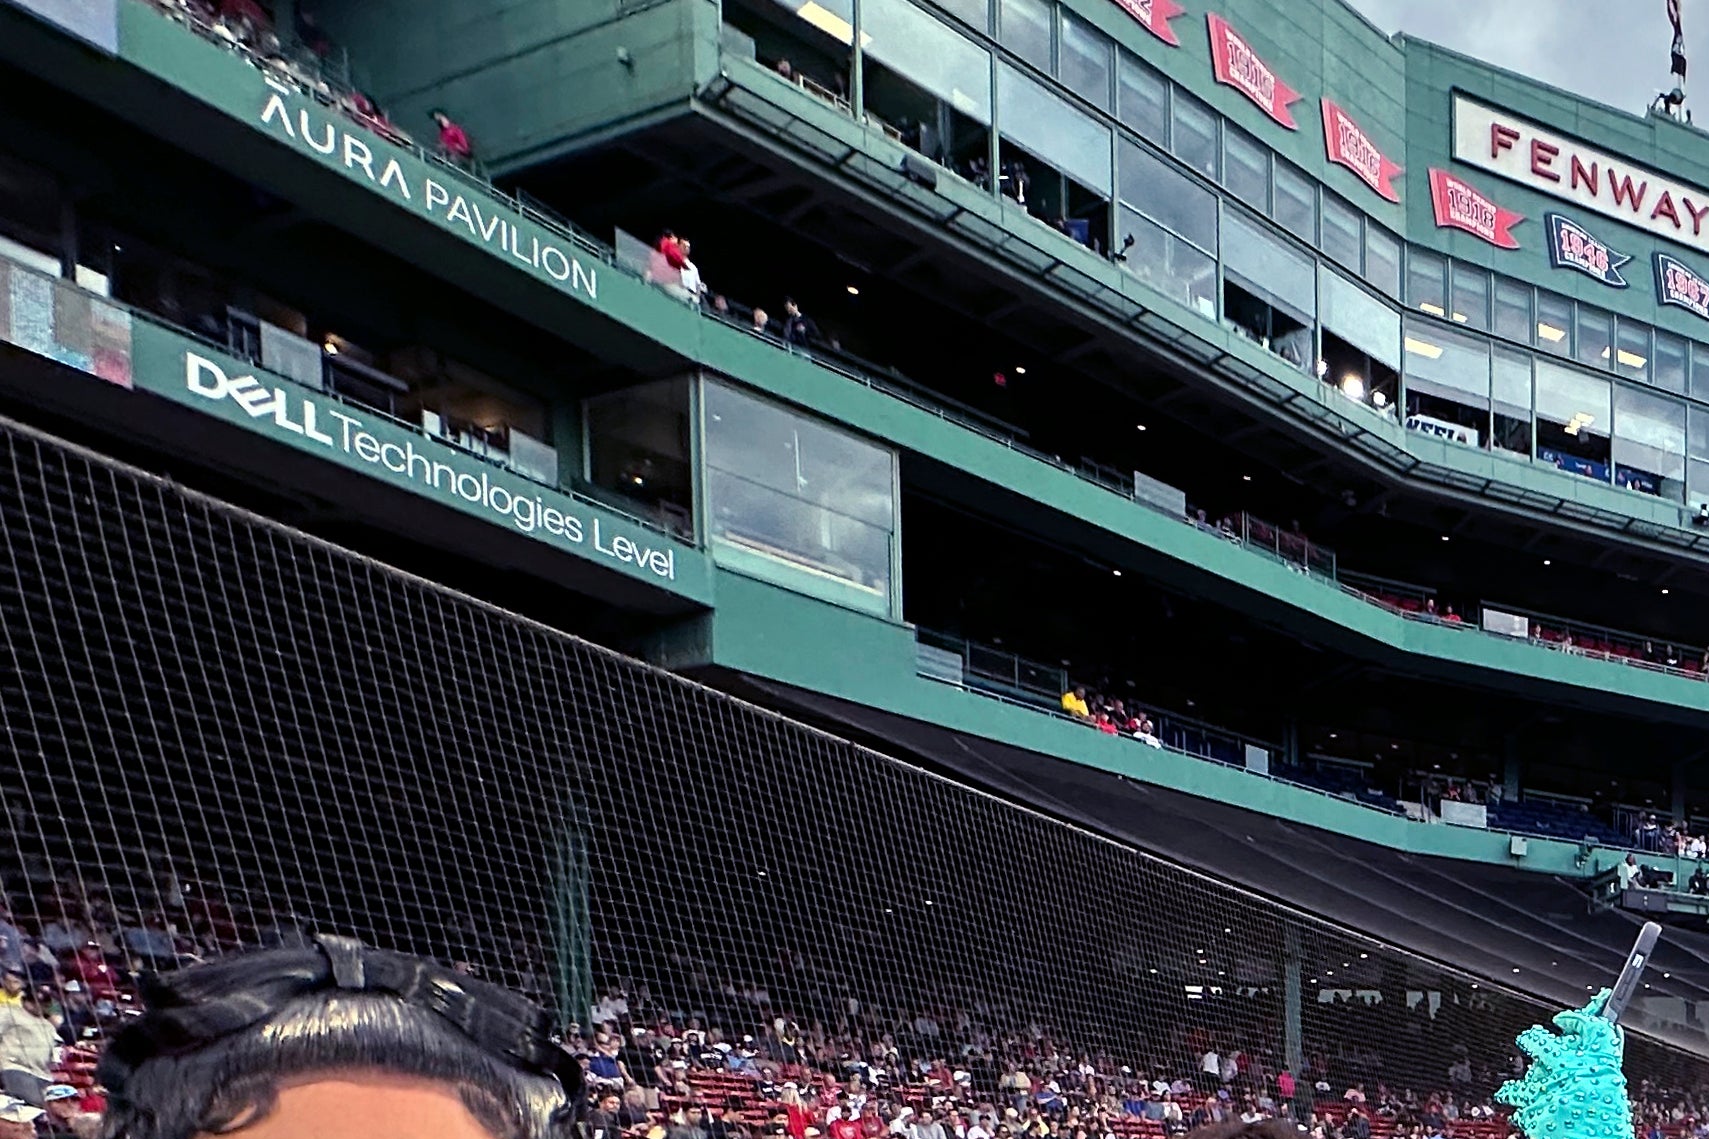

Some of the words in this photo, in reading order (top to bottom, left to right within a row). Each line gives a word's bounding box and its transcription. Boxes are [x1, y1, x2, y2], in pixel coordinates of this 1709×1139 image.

[425, 178, 597, 299] PAVILION
[1447, 188, 1496, 231] 1918
[1560, 229, 1609, 272] 1946
[185, 351, 334, 447] DELL
[329, 409, 583, 544] Technologies
[594, 517, 675, 581] Level
